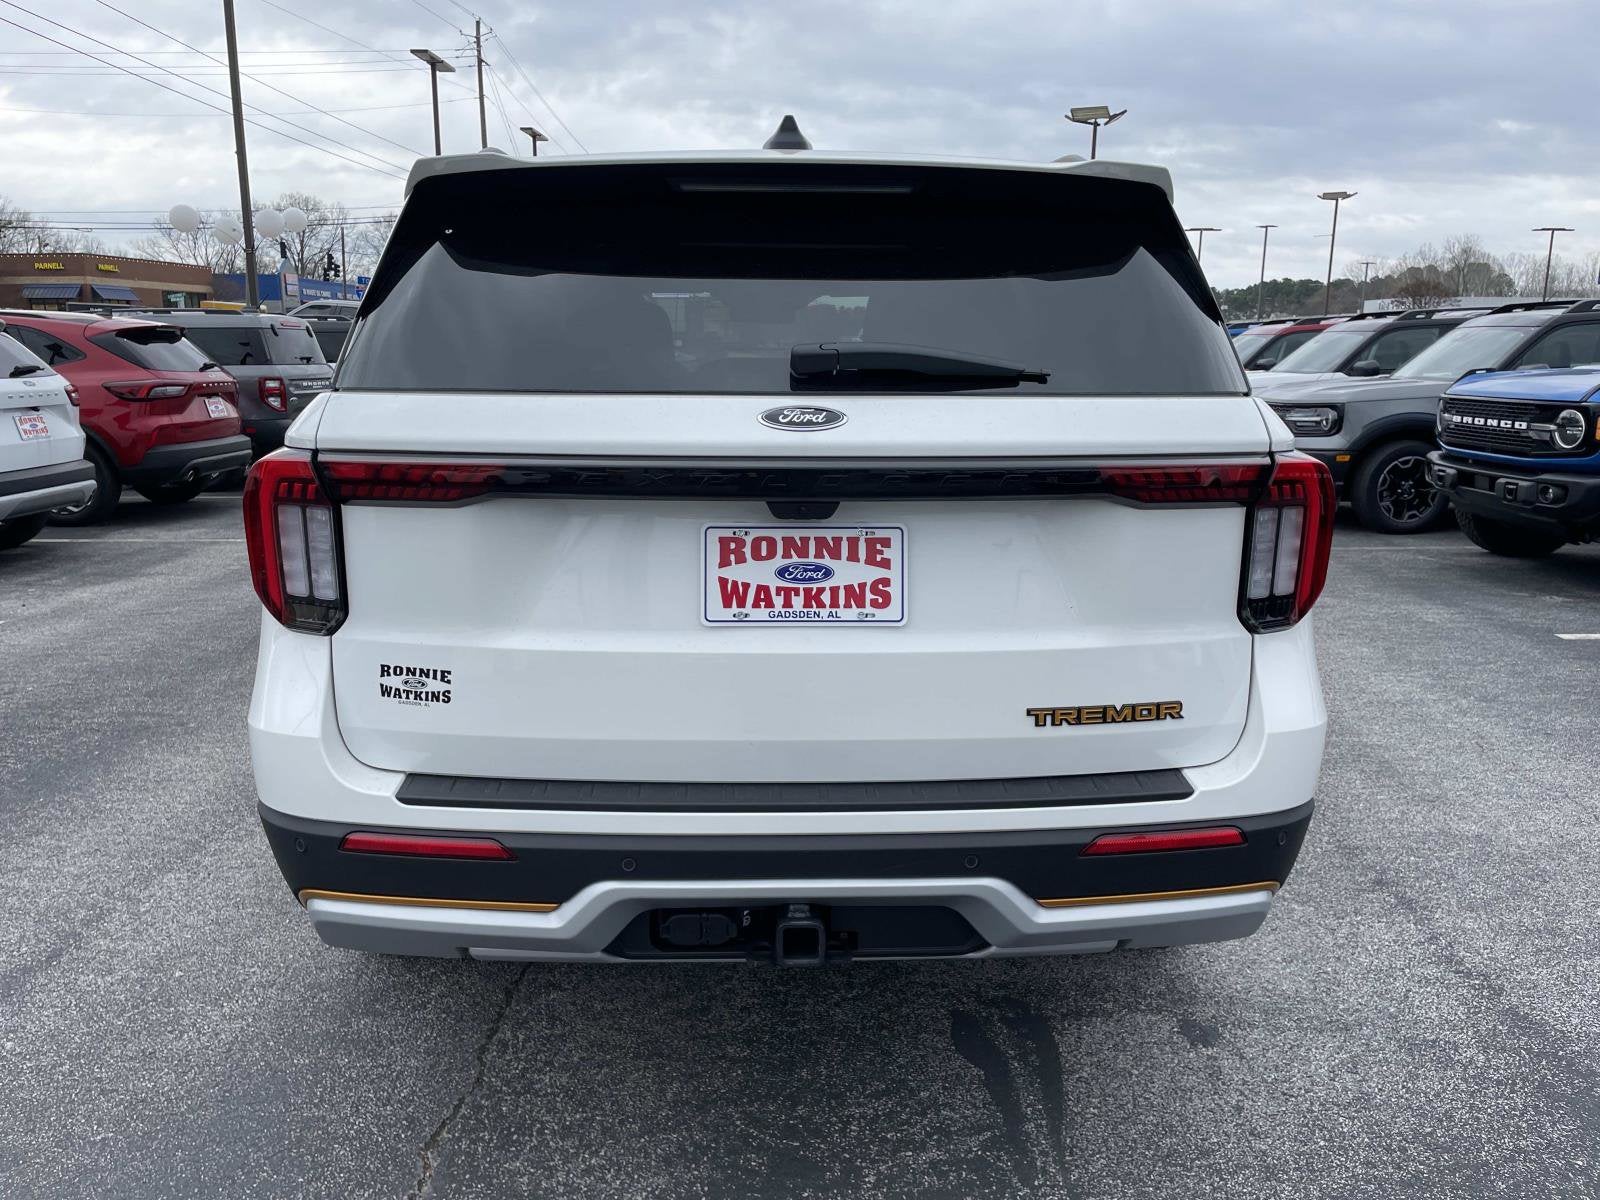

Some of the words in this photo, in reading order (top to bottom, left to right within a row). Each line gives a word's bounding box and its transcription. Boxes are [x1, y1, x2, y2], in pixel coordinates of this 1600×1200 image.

[34, 262, 65, 270] PARNELL
[98, 264, 120, 272] PARNELL
[778, 407, 827, 423] Ford
[1453, 415, 1528, 430] BRONCO
[718, 536, 892, 571] RONNIE
[784, 565, 826, 580] Ford
[718, 575, 892, 610] WATKINS
[768, 610, 824, 620] GADSDEN,
[827, 610, 841, 619] AL
[380, 663, 452, 685] RONNIE
[380, 682, 452, 704] WATKINS
[1026, 700, 1184, 727] TREMOR
